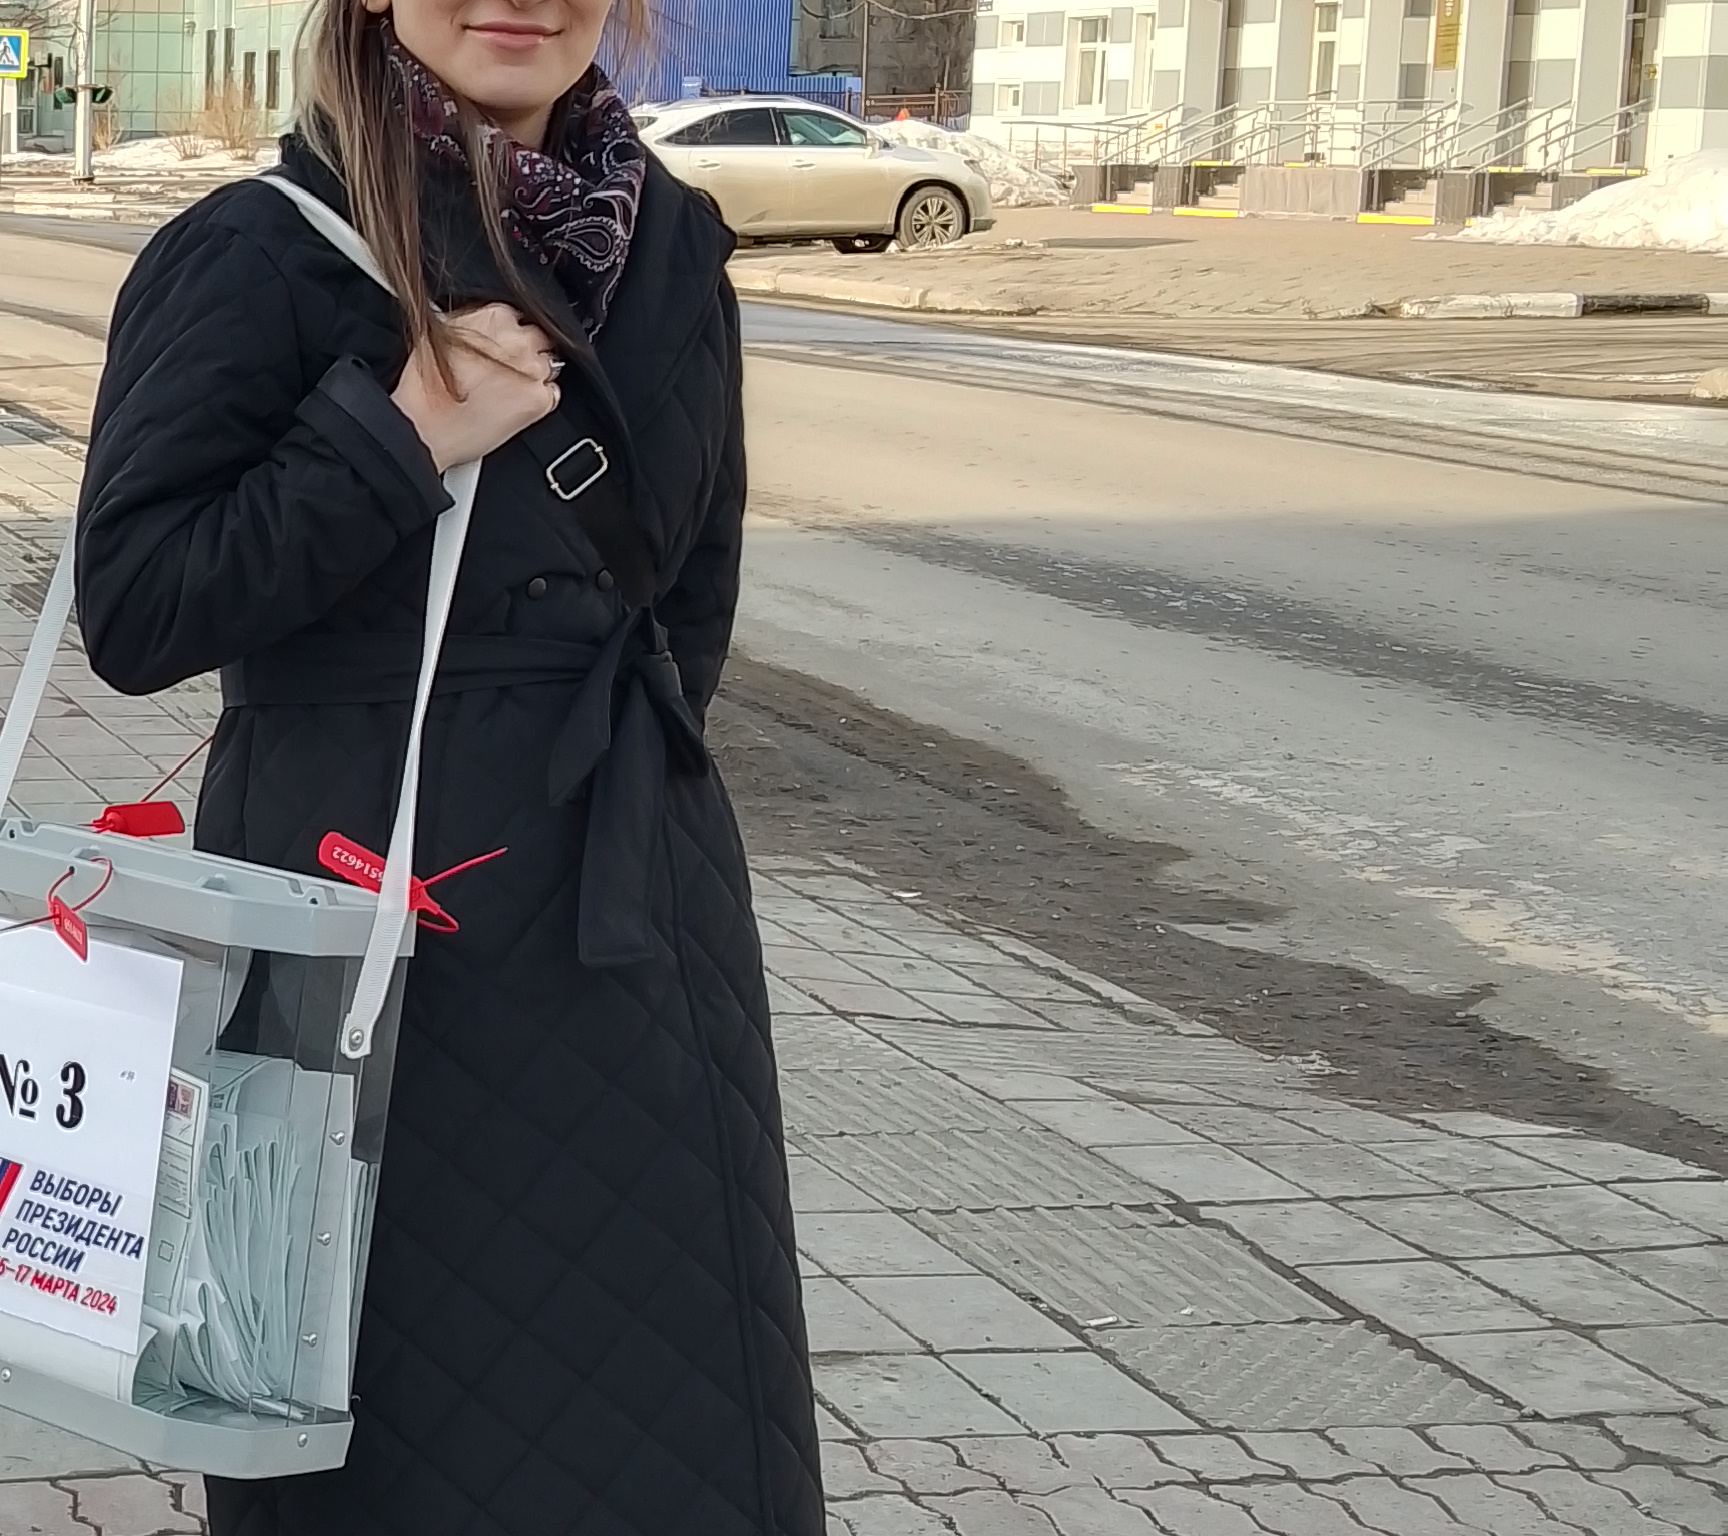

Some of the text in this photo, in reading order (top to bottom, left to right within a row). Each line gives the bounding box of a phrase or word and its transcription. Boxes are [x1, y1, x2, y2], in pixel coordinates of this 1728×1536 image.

[56, 1061, 86, 1129] 3
[30, 1169, 123, 1217] ВЫБОРЫ
[2, 1228, 86, 1273] РОССИИ
[15, 1199, 145, 1259] ПРЕЗИДЕНТА
[30, 1269, 81, 1302] МАРТА
[80, 1287, 118, 1315] 2024
